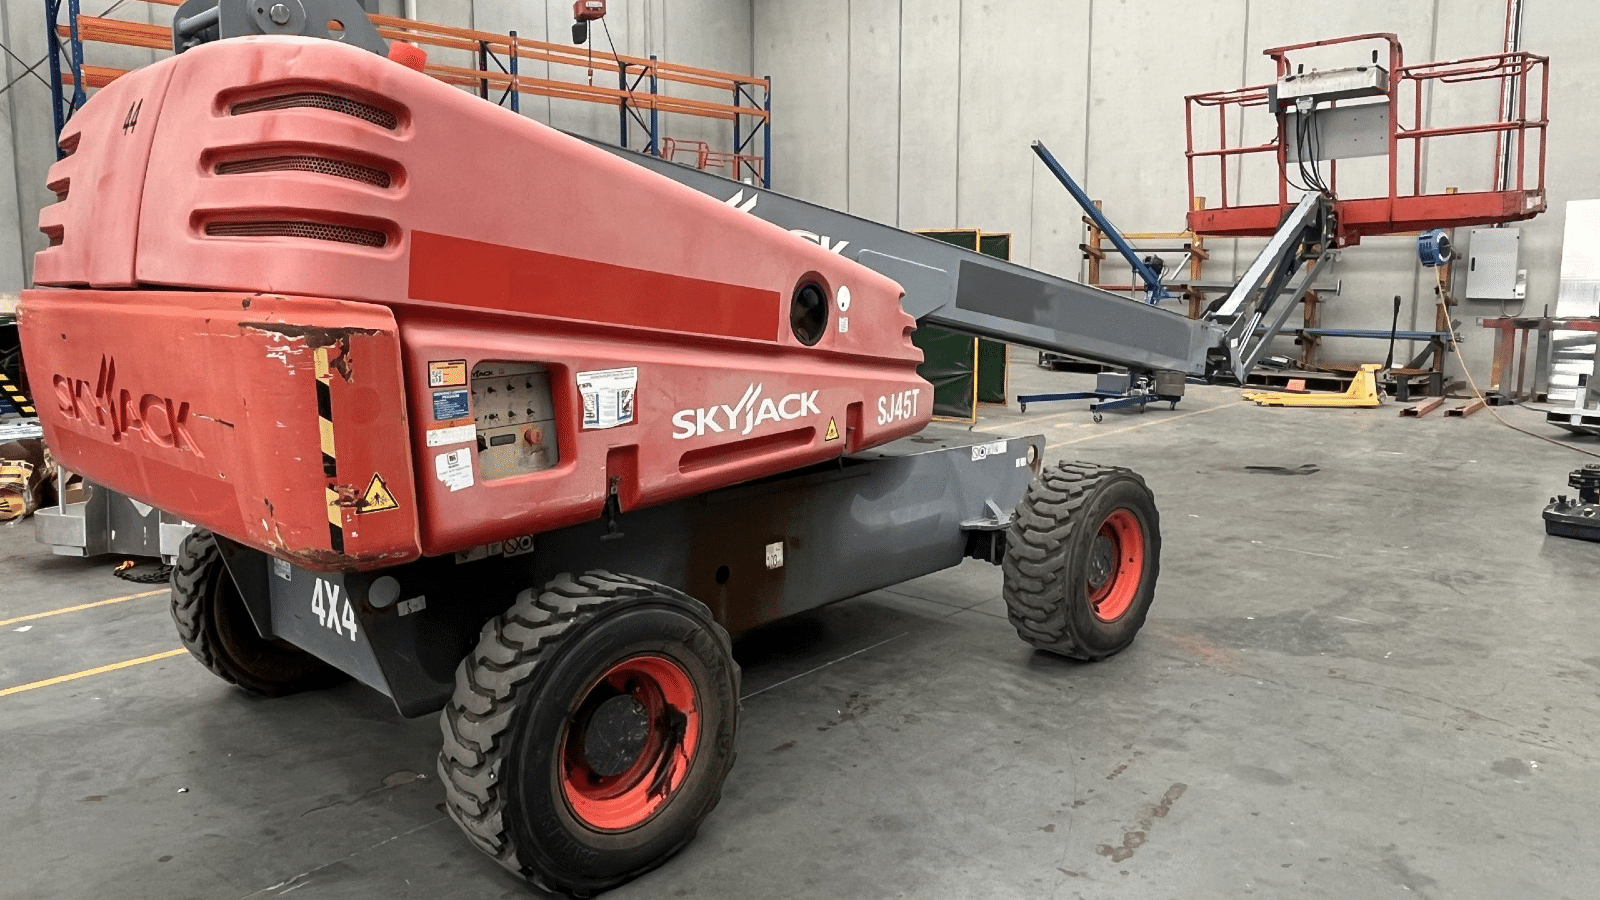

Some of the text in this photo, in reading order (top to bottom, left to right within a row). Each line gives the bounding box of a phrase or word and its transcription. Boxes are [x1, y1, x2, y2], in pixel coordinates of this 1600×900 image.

[52, 353, 205, 458] SKYJACK
[672, 382, 821, 440] SKYJACK
[877, 388, 920, 426] SJ45T
[311, 577, 358, 642] 4X4
